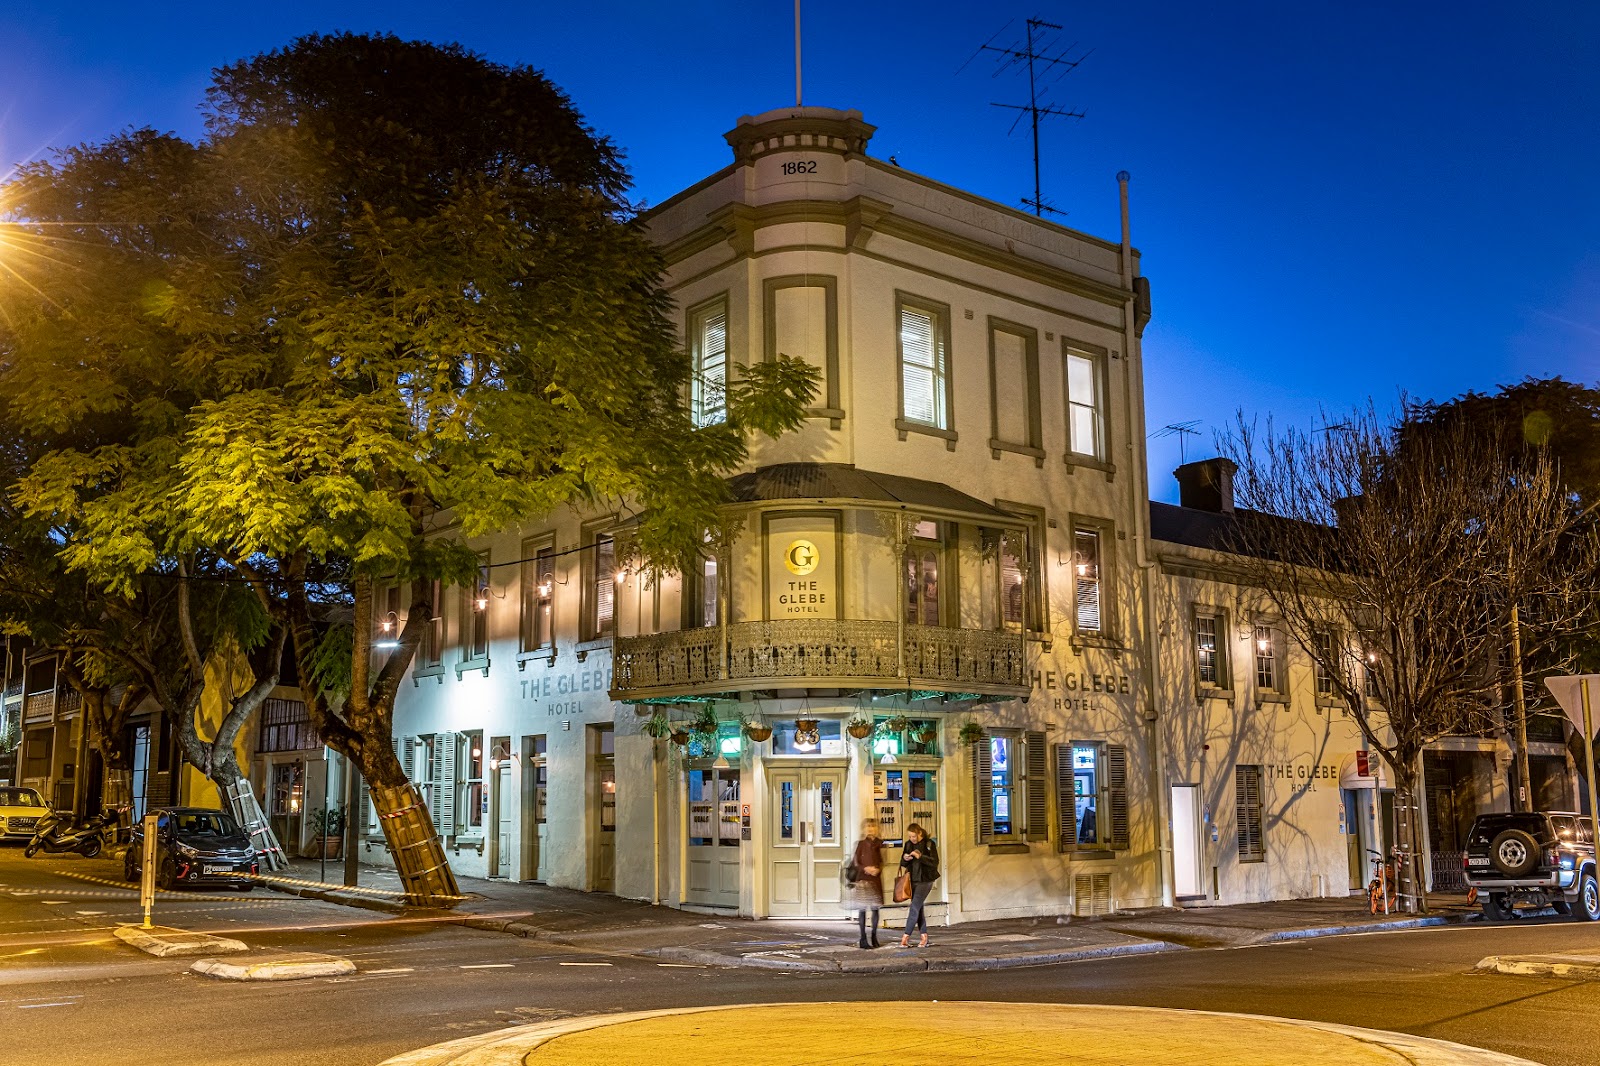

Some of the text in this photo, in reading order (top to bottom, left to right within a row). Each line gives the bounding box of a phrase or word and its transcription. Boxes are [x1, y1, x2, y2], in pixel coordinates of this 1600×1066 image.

[781, 160, 817, 175] 1862
[789, 545, 814, 567] G
[788, 581, 817, 591] THE
[779, 593, 825, 604] GLEBE
[520, 676, 551, 699] THE
[1030, 669, 1129, 695] HE GLEBE
[548, 701, 583, 716] HOTEL
[1054, 698, 1096, 711] HOTEL
[1268, 765, 1337, 779] THE GLEBE
